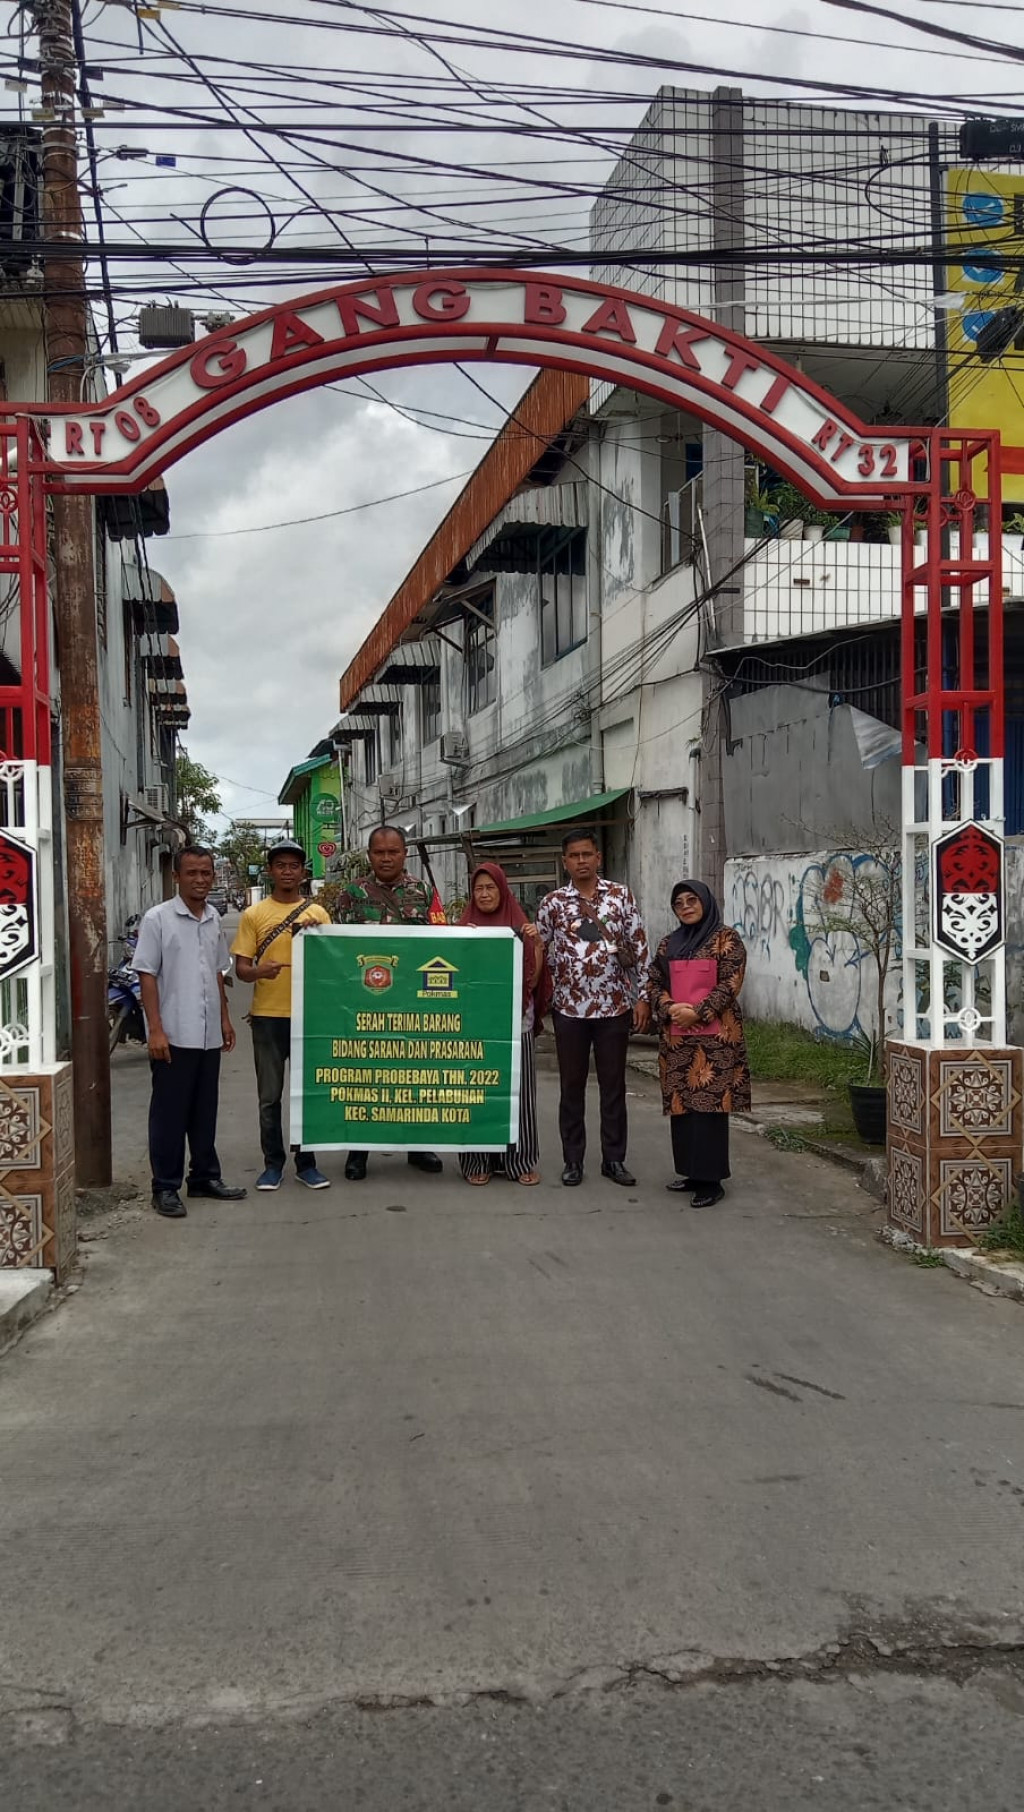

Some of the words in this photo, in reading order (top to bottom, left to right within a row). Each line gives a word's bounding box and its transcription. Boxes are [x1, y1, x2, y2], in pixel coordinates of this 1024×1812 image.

[189, 280, 471, 389] GANG
[523, 283, 792, 413] BAKTI
[65, 421, 106, 455] RT
[115, 397, 161, 442] 08
[811, 418, 854, 462] RT
[857, 443, 898, 477] 32
[356, 1012, 385, 1031] SERAH
[387, 1012, 420, 1032] TERIMA
[423, 1013, 461, 1032] BARANG
[332, 1039, 367, 1058] BIDANG
[368, 1040, 405, 1059] SARANA
[408, 1040, 428, 1059] DAN
[429, 1041, 484, 1060] PRASARANA
[315, 1067, 373, 1084] PROGRAM
[374, 1068, 440, 1085] PROBEBAYA
[442, 1069, 468, 1085] THN.
[469, 1069, 499, 1086] 2022
[330, 1086, 379, 1103] POKMAS
[394, 1088, 417, 1104] KEL.
[418, 1088, 485, 1105] PELABUHAN
[344, 1105, 370, 1121] KEC.
[371, 1106, 440, 1123] SAMARINDA
[441, 1107, 471, 1123] KOTA
